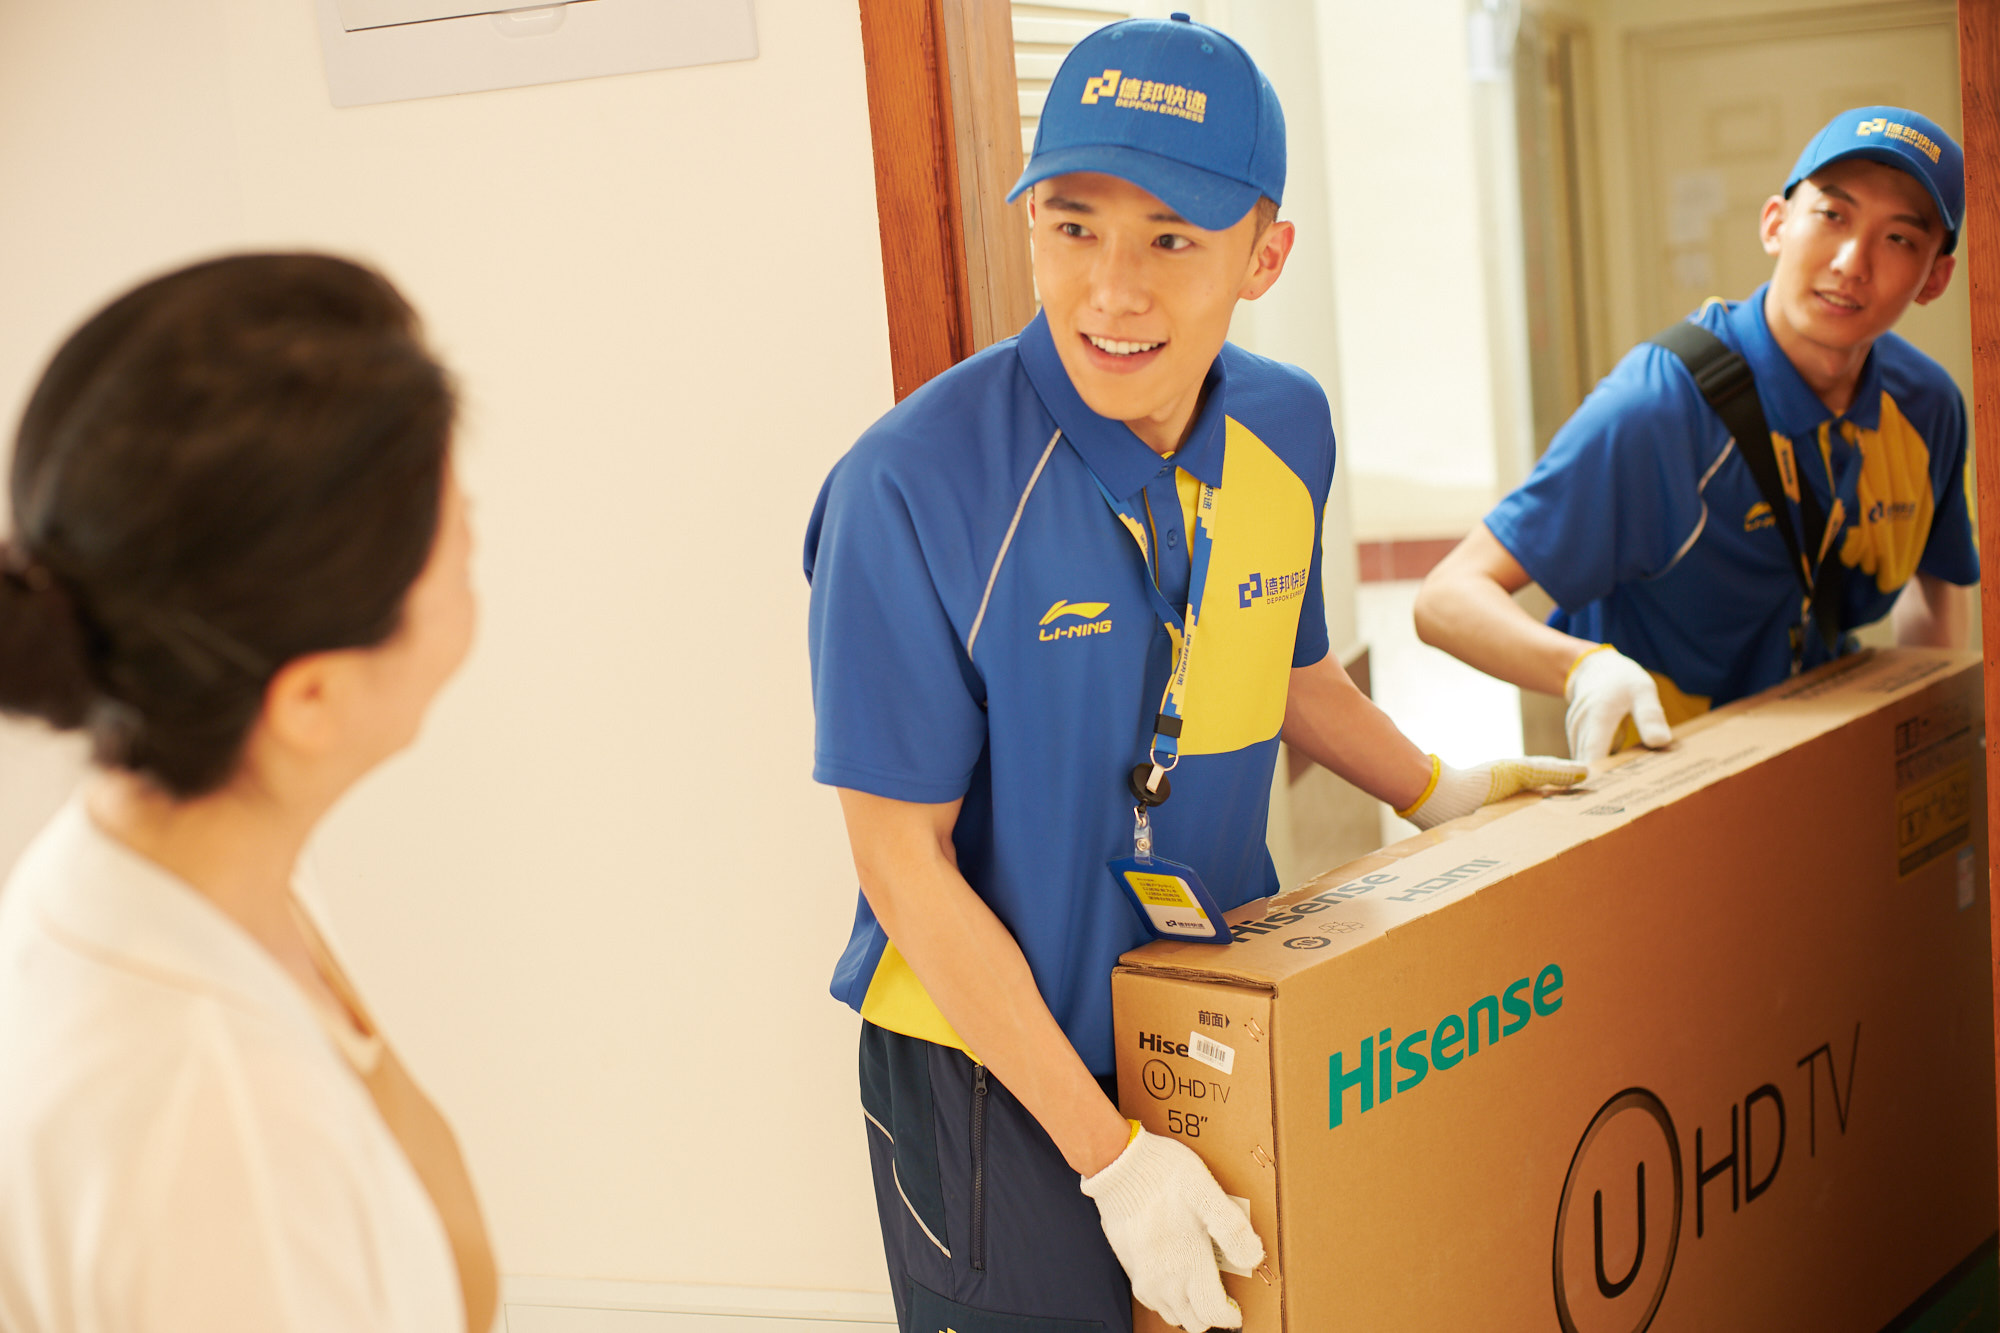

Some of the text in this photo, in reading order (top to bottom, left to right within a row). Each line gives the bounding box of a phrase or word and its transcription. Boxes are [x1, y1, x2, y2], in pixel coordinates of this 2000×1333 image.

[1117, 77, 1207, 114] 德邦快递
[1115, 97, 1204, 123] DEPPON EXPRESS
[1039, 620, 1112, 641] LI-NING
[1232, 873, 1400, 943] Hisense
[1198, 1010, 1223, 1028] 前面
[1139, 1031, 1189, 1058] Hise
[1329, 963, 1564, 1131] Hisense
